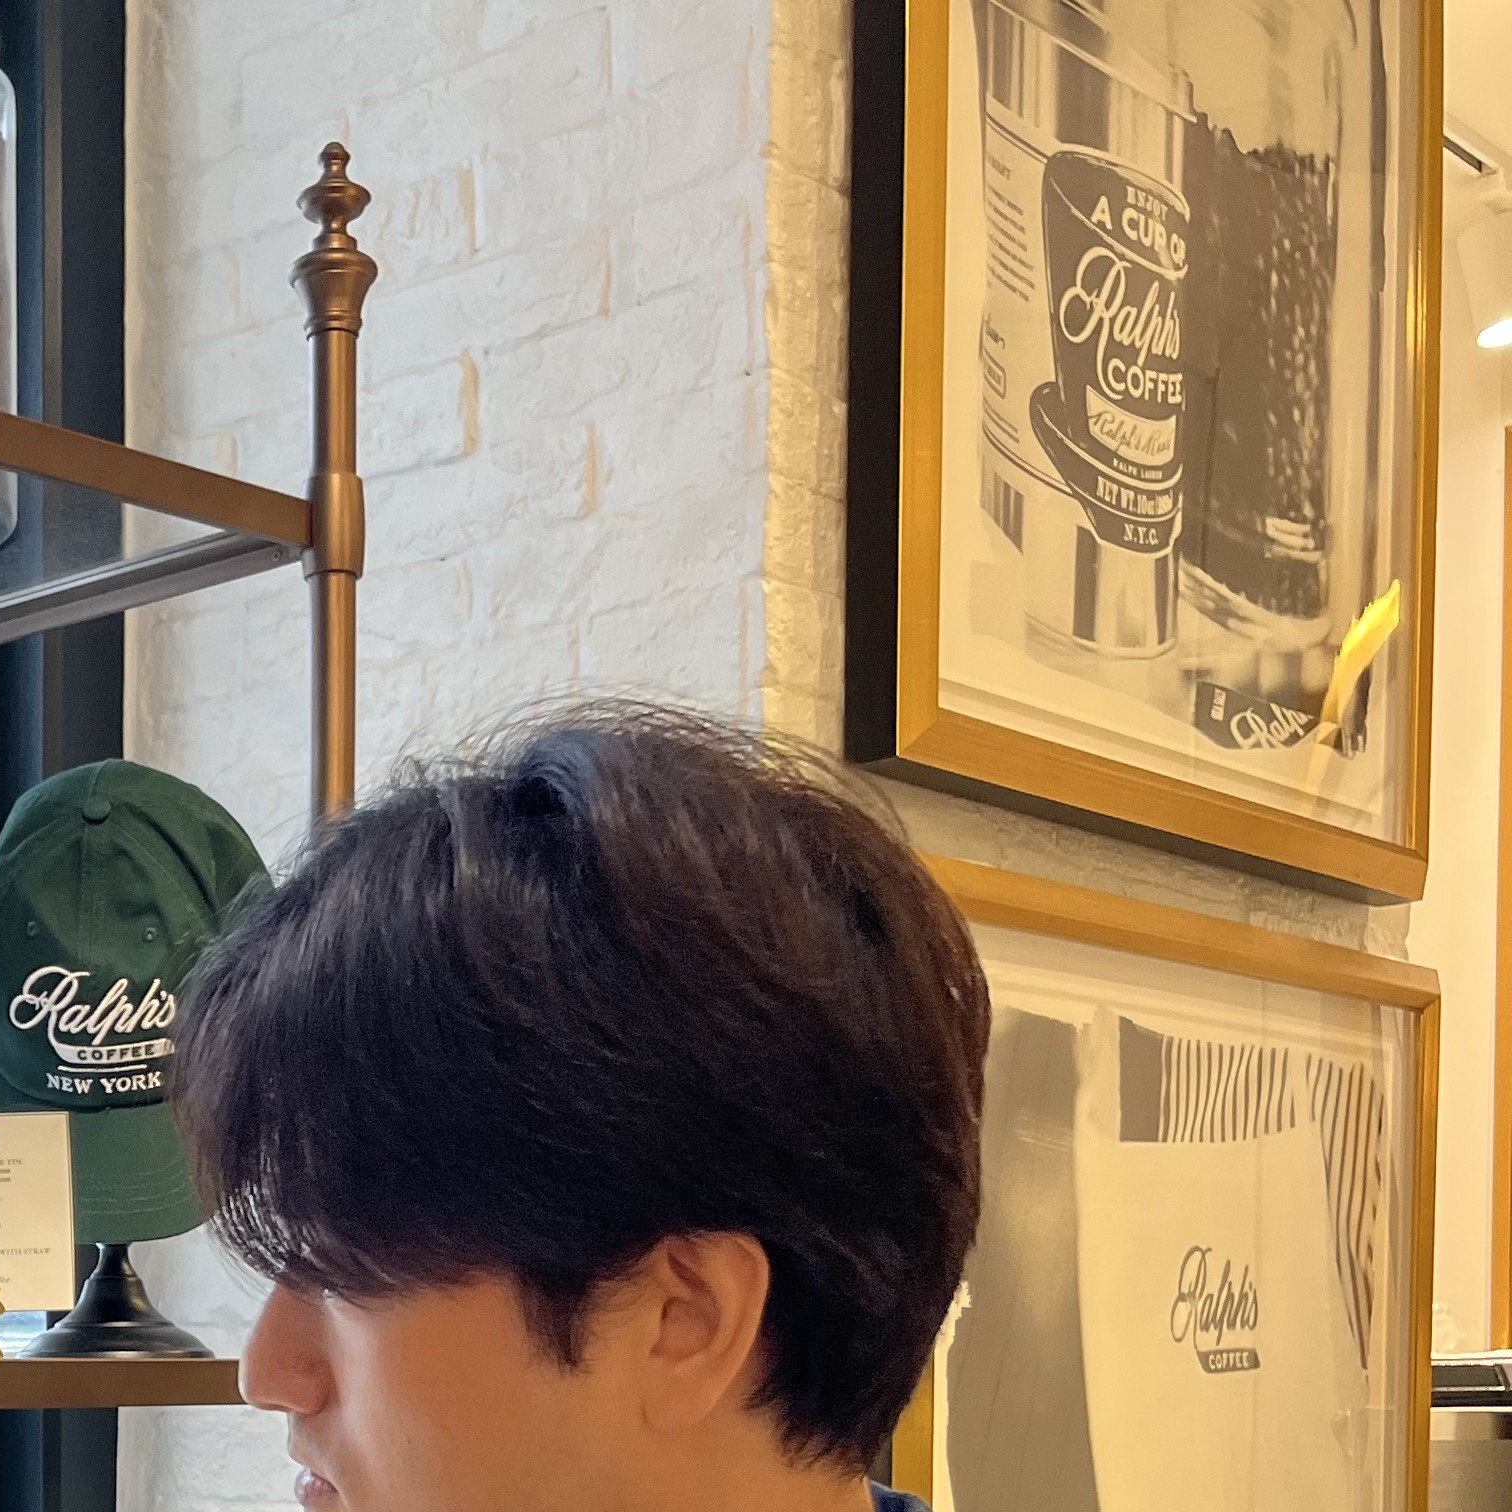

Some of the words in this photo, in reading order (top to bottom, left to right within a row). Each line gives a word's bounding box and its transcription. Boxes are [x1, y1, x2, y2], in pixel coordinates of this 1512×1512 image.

[1126, 185, 1168, 221] ENJOY
[1091, 195, 1113, 230] A
[1122, 207, 1167, 251] CUP
[1060, 246, 1180, 399] Ralph's
[1096, 476, 1118, 505] NET
[9, 966, 176, 1047] Ralph's
[77, 1044, 155, 1060] COFFEE
[46, 1073, 93, 1094] NEW
[100, 1072, 161, 1094] YORK
[1171, 1245, 1258, 1347] Ralph's
[1209, 1352, 1249, 1369] COFFEE
